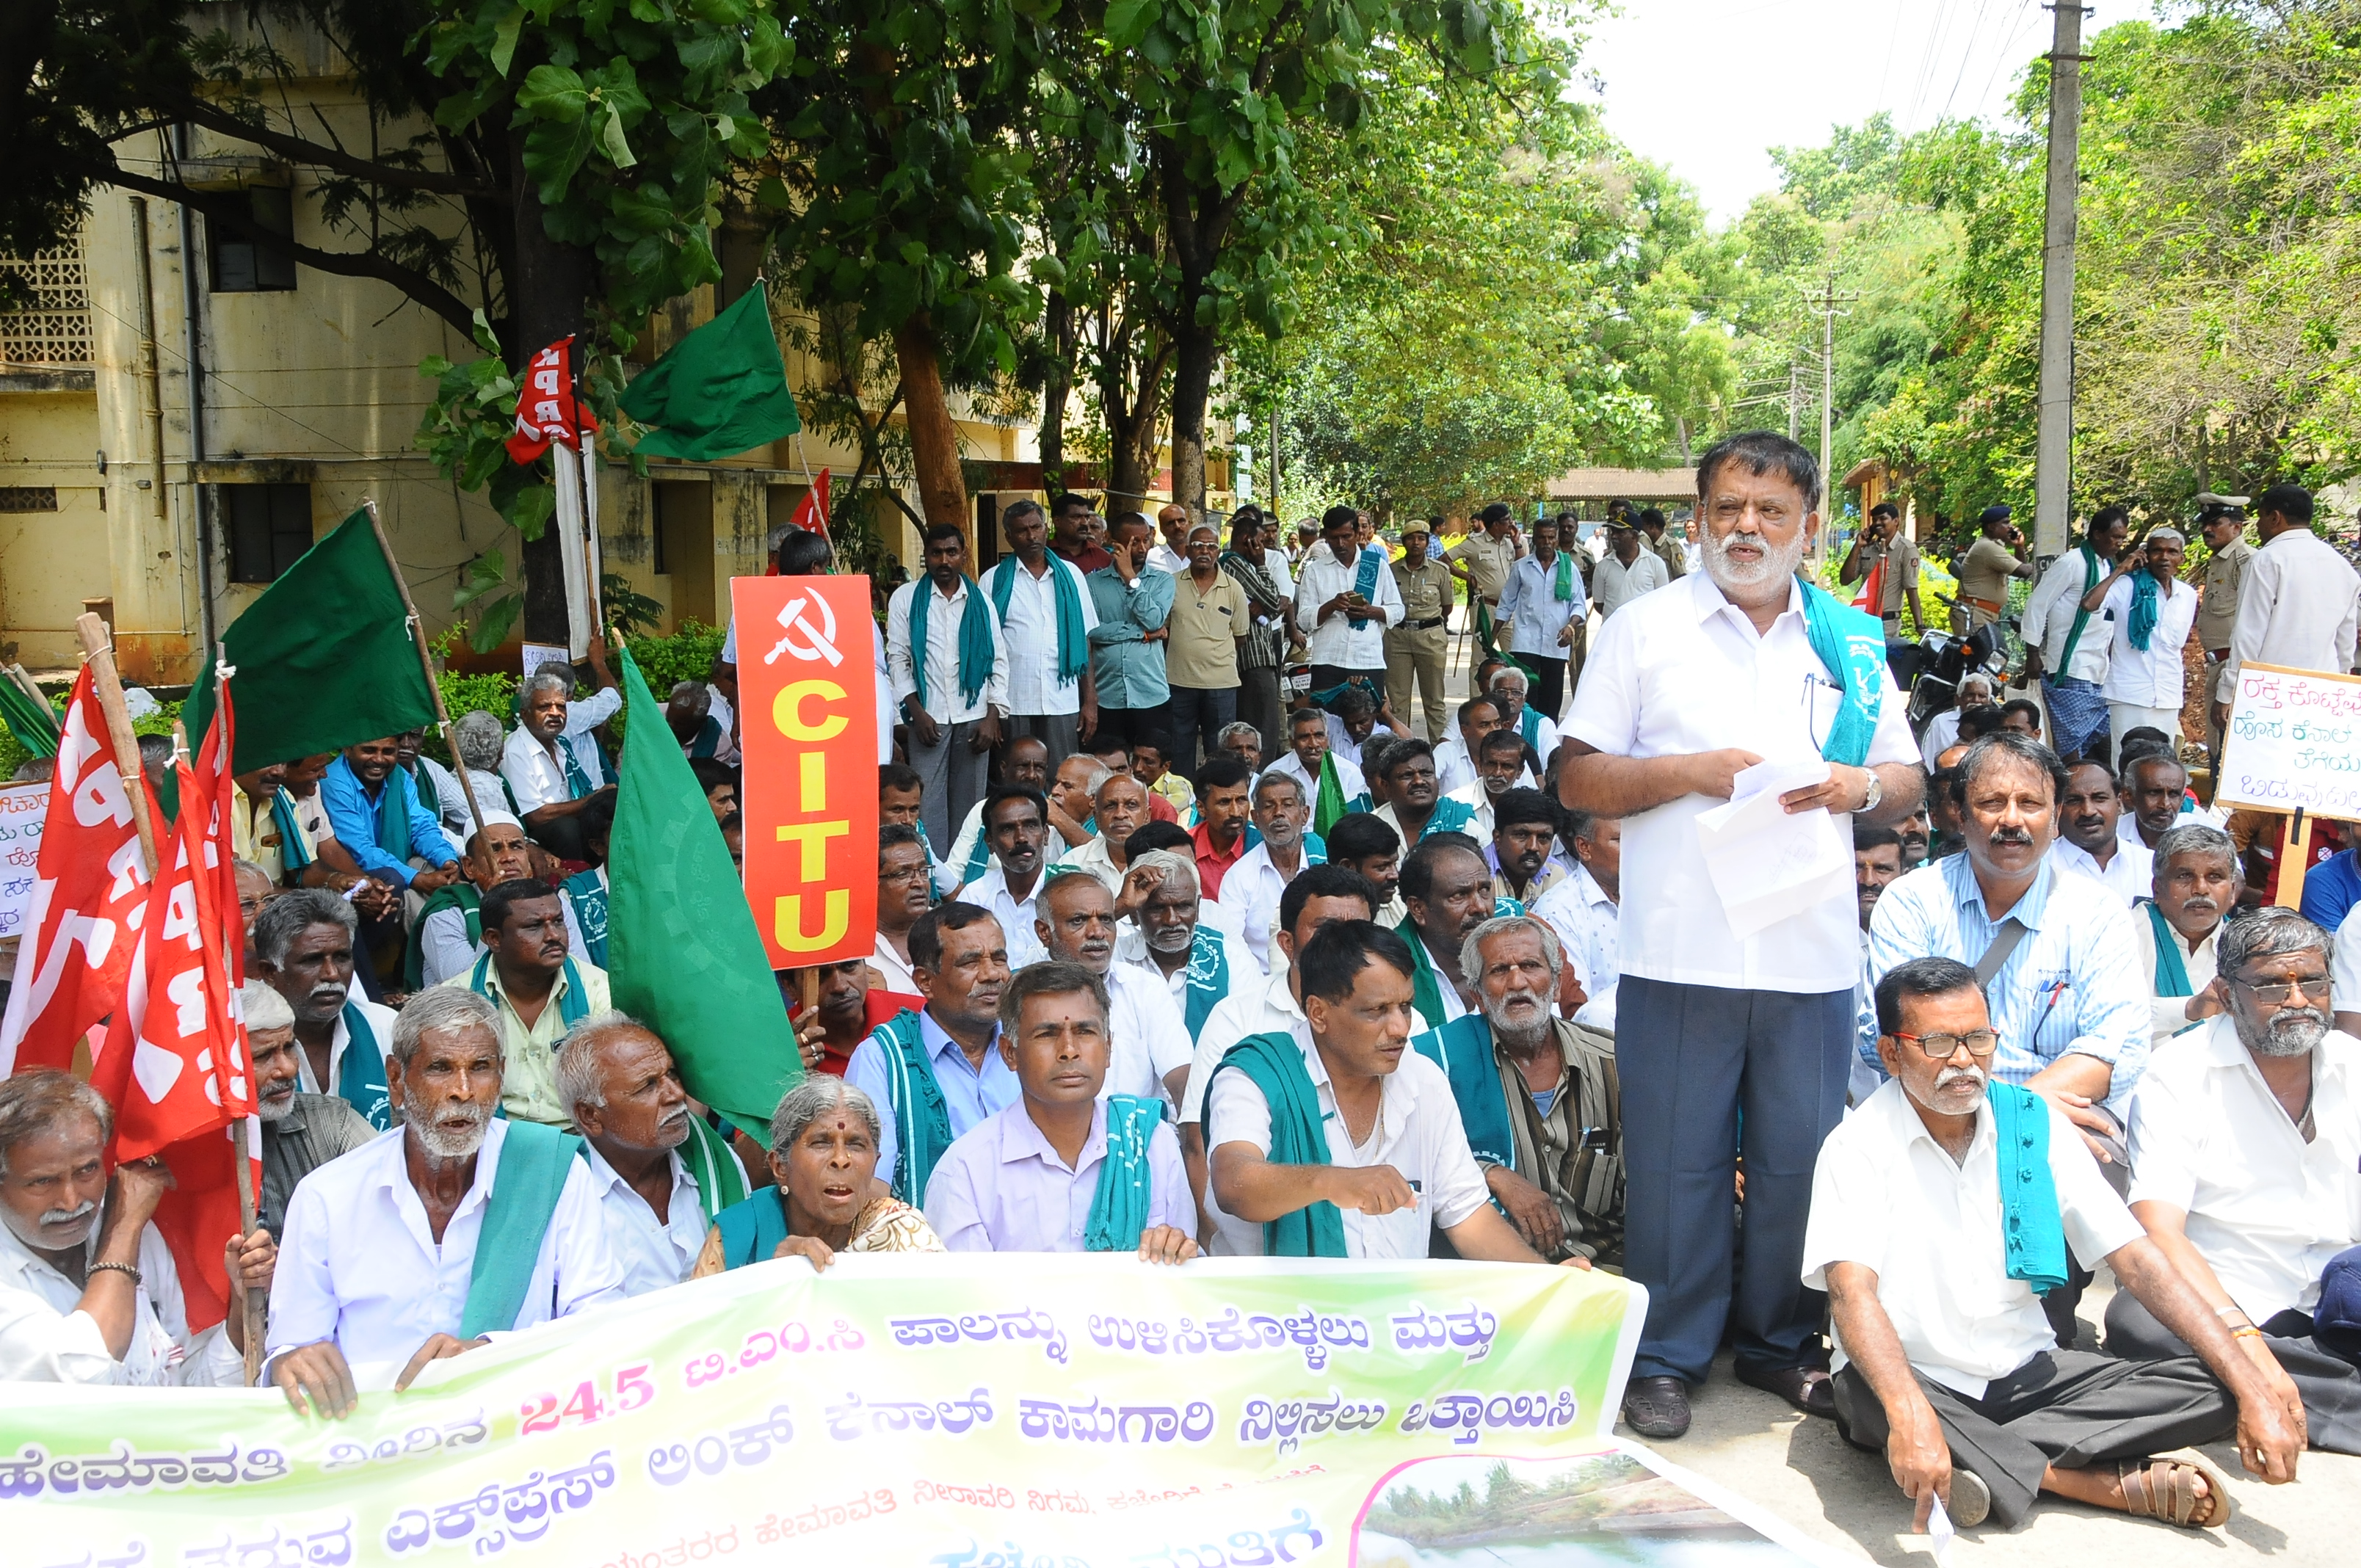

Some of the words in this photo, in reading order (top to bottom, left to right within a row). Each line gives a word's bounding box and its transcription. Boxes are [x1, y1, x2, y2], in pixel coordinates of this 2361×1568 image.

[772, 679, 849, 953] CITU
[0, 1441, 287, 1499] ಹೇಮಾವತಿ
[521, 1364, 655, 1437] 24.5
[890, 1306, 1070, 1364] ಪಾಲನ್ನು
[1393, 1303, 1496, 1361] ಮತ್ತು
[648, 1405, 794, 1487] ಲಿಂಕ್
[825, 1388, 994, 1442] ಕೆನಾಲ್
[1019, 1394, 1215, 1443] ಕಾಮಗಾರಿ
[1240, 1387, 1385, 1453] ನಿಲ್ಲಿಸಲು
[1400, 1390, 1575, 1445] ಒತ್ತಾಯಿಸಿ
[754, 1487, 898, 1545] ಹೇಮಾವತಿ
[913, 1478, 1016, 1509] ನೀರಾವರಿ
